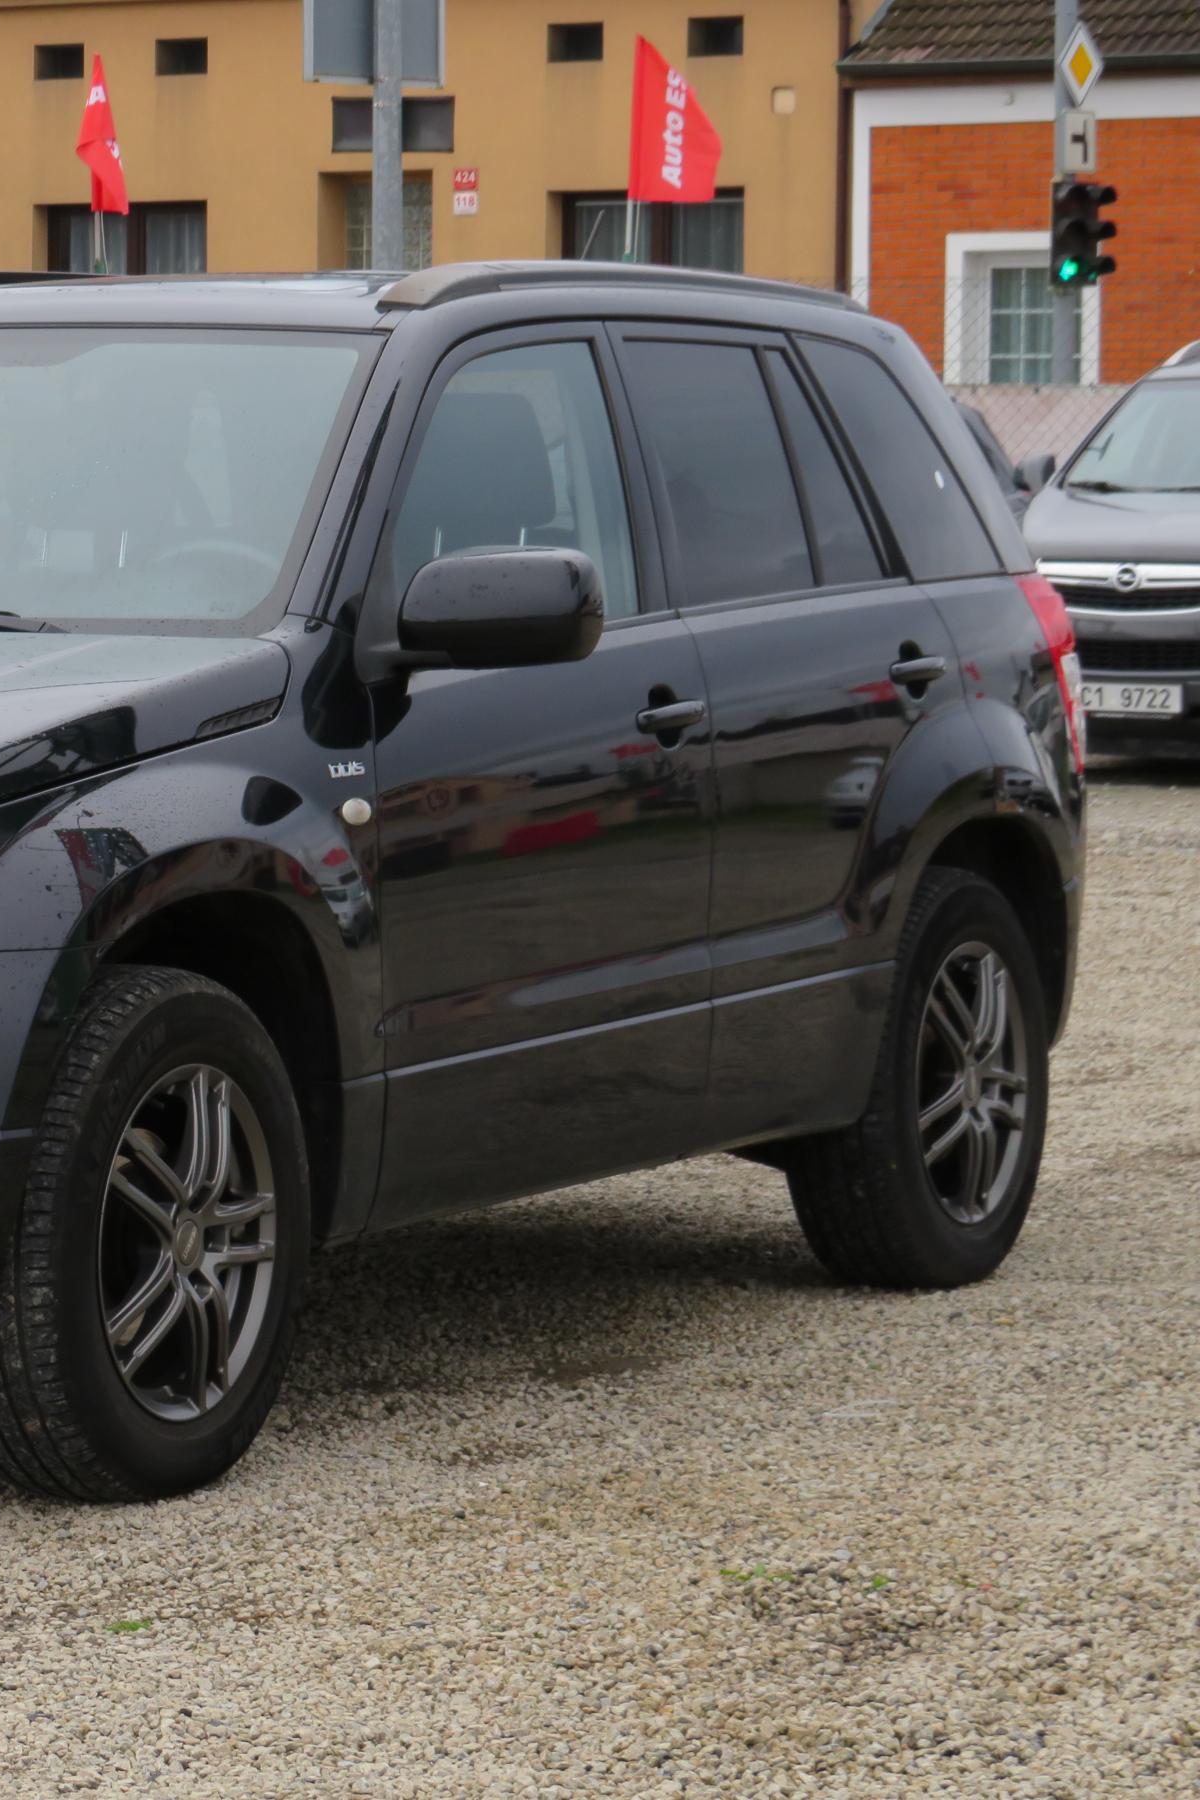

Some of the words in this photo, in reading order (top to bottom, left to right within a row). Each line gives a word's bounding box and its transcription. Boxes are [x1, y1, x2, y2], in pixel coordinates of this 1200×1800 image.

[664, 65, 688, 110] ES
[661, 110, 684, 189] Auto
[455, 171, 475, 183] 424
[1081, 686, 1104, 708] C1
[1120, 687, 1171, 709] 9722
